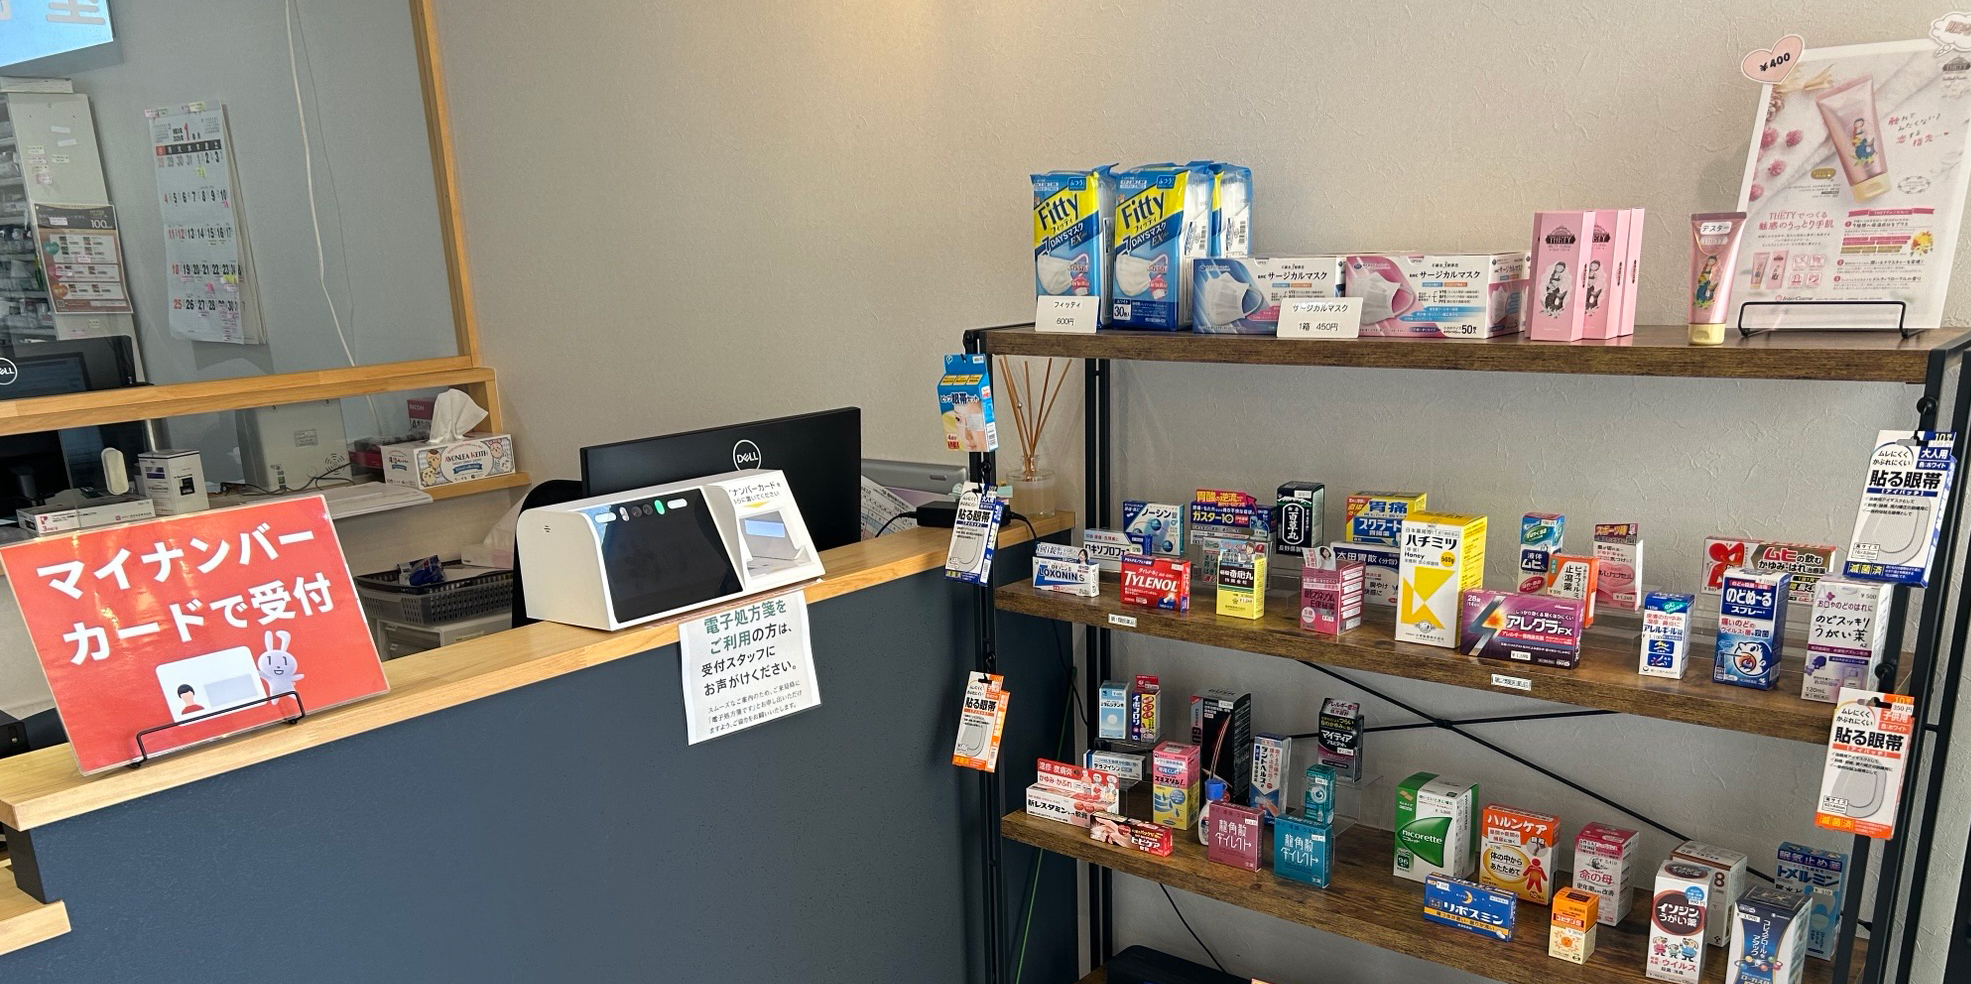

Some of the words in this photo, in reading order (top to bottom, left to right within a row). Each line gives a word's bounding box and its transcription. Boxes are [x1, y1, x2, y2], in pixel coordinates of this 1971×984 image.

[1759, 52, 1791, 72] ¥400
[1038, 193, 1079, 231] Fitty
[1121, 192, 1165, 229] Fitty
[1701, 224, 1730, 233] テスター
[1758, 220, 1834, 231] 魅惑のうっとり手肌
[1268, 271, 1328, 281] サージカルマスク
[1420, 271, 1481, 279] サージカルマスク
[1054, 301, 1081, 309] フィッティ
[1292, 303, 1349, 313] サージカルマスク
[1056, 317, 1075, 326] 600円
[1299, 322, 1310, 331] 1箱
[1315, 323, 1339, 332] 450円
[0, 366, 14, 375] ELL
[737, 452, 758, 463] DELL
[1921, 450, 1948, 459] 大人用
[1869, 470, 1942, 490] 貼る眼帯
[729, 482, 781, 496] ナンバーカードを
[1368, 501, 1408, 514] 胃痛
[958, 508, 991, 523] 貼る眼帯
[1192, 510, 1234, 524] ガスター10
[1287, 511, 1299, 540] 百草丸
[1359, 518, 1402, 532] スクラート
[1085, 543, 1130, 556] ロキソプロフェ
[1405, 534, 1458, 550] ハチミツ
[37, 522, 314, 599] マイナンバー
[1337, 551, 1378, 563] 太田胃散
[1404, 551, 1426, 560] Honey
[1527, 552, 1543, 560] 液体
[1763, 547, 1823, 564] ムヒの飲む
[1039, 565, 1078, 581] LOXONIN
[1079, 574, 1085, 582] S
[1758, 561, 1826, 574] かゆみ・はれ治療薬
[1124, 570, 1179, 592] TYLENOL
[1369, 582, 1389, 590] 胸やけ
[1573, 565, 1582, 598] ビオフェルミ
[1730, 606, 1763, 615] スプレー
[1817, 600, 1873, 612] お口やのどのはれに
[63, 572, 335, 665] カードで受付
[704, 599, 787, 635] 電子処方箋を
[1721, 617, 1755, 628] 痛いのどの
[1815, 615, 1870, 629] のどスッキリ
[1506, 614, 1573, 636] アレグラFX
[710, 623, 792, 655] ご利用の方は、
[1815, 625, 1868, 642] うがい薬
[701, 645, 776, 678] 受付スタッフに
[704, 660, 797, 696] お声がけください。
[965, 697, 997, 712] 貼る眼帯
[1841, 709, 1871, 718] ムレにくく
[1320, 729, 1353, 743] マイティア
[1834, 727, 1904, 751] 貼る眼帯
[1039, 775, 1055, 784] かゆみ
[1056, 778, 1073, 788] かぶれ
[1028, 799, 1068, 813] 新レスタミン
[1218, 819, 1247, 838] 龍角散
[1487, 814, 1548, 835] ハルンケア
[1131, 836, 1161, 849] ヒビケア
[1214, 832, 1252, 851] ダイレクト
[1284, 833, 1314, 853] 龍角散
[1402, 829, 1443, 845] nicorette
[1280, 846, 1319, 867] ダイレクト
[1490, 851, 1523, 866] 体の中から
[1779, 850, 1842, 870] 眠気止め薬
[1490, 862, 1521, 876] あたためて
[1777, 865, 1840, 887] トメルミン
[1579, 869, 1613, 885] 命の母
[1714, 871, 1725, 887] 8
[1443, 901, 1503, 925] リポスミン
[1657, 902, 1699, 918] イソジン
[1658, 913, 1697, 928] うがい薬
[1662, 959, 1697, 972] ウイルス
